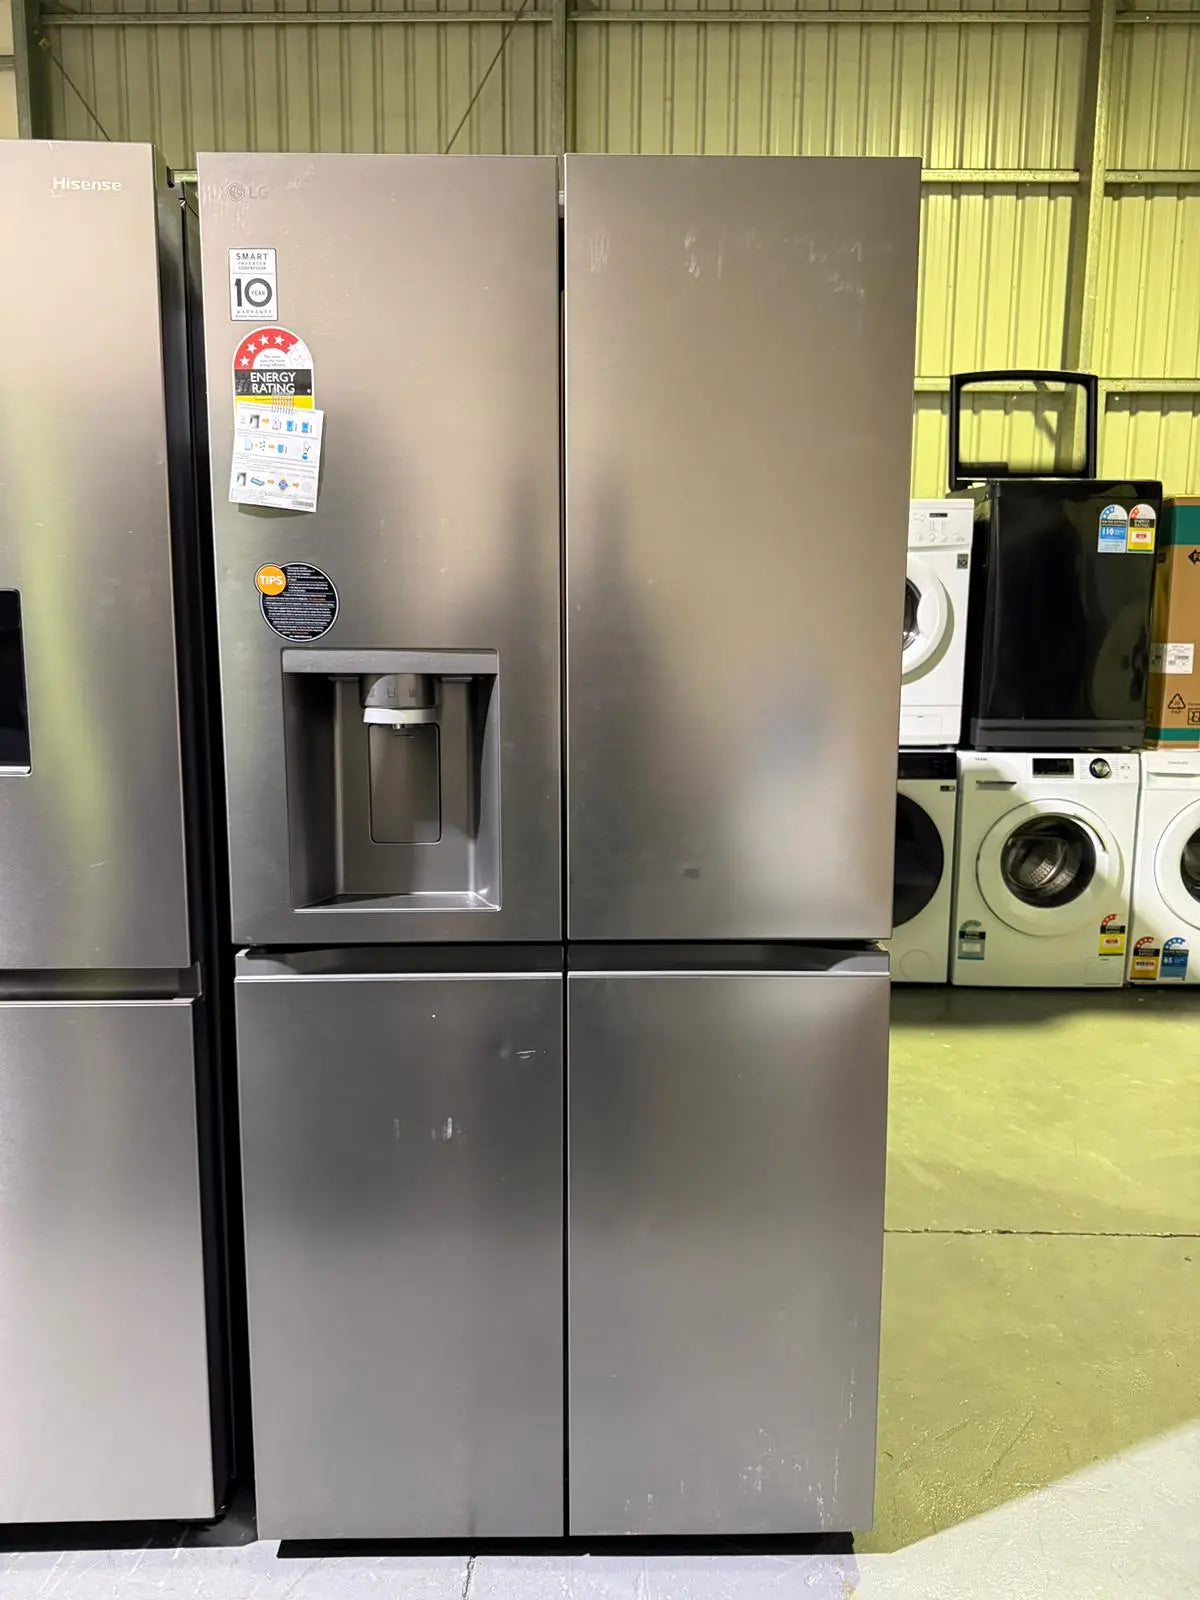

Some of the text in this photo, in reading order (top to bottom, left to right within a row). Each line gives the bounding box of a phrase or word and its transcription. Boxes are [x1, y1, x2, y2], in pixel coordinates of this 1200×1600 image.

[52, 177, 122, 191] Hisense
[248, 185, 269, 199] LG
[234, 278, 273, 308] 10
[250, 372, 296, 383] ENERGY
[252, 383, 296, 394] RATING
[259, 575, 283, 585] TIPS
